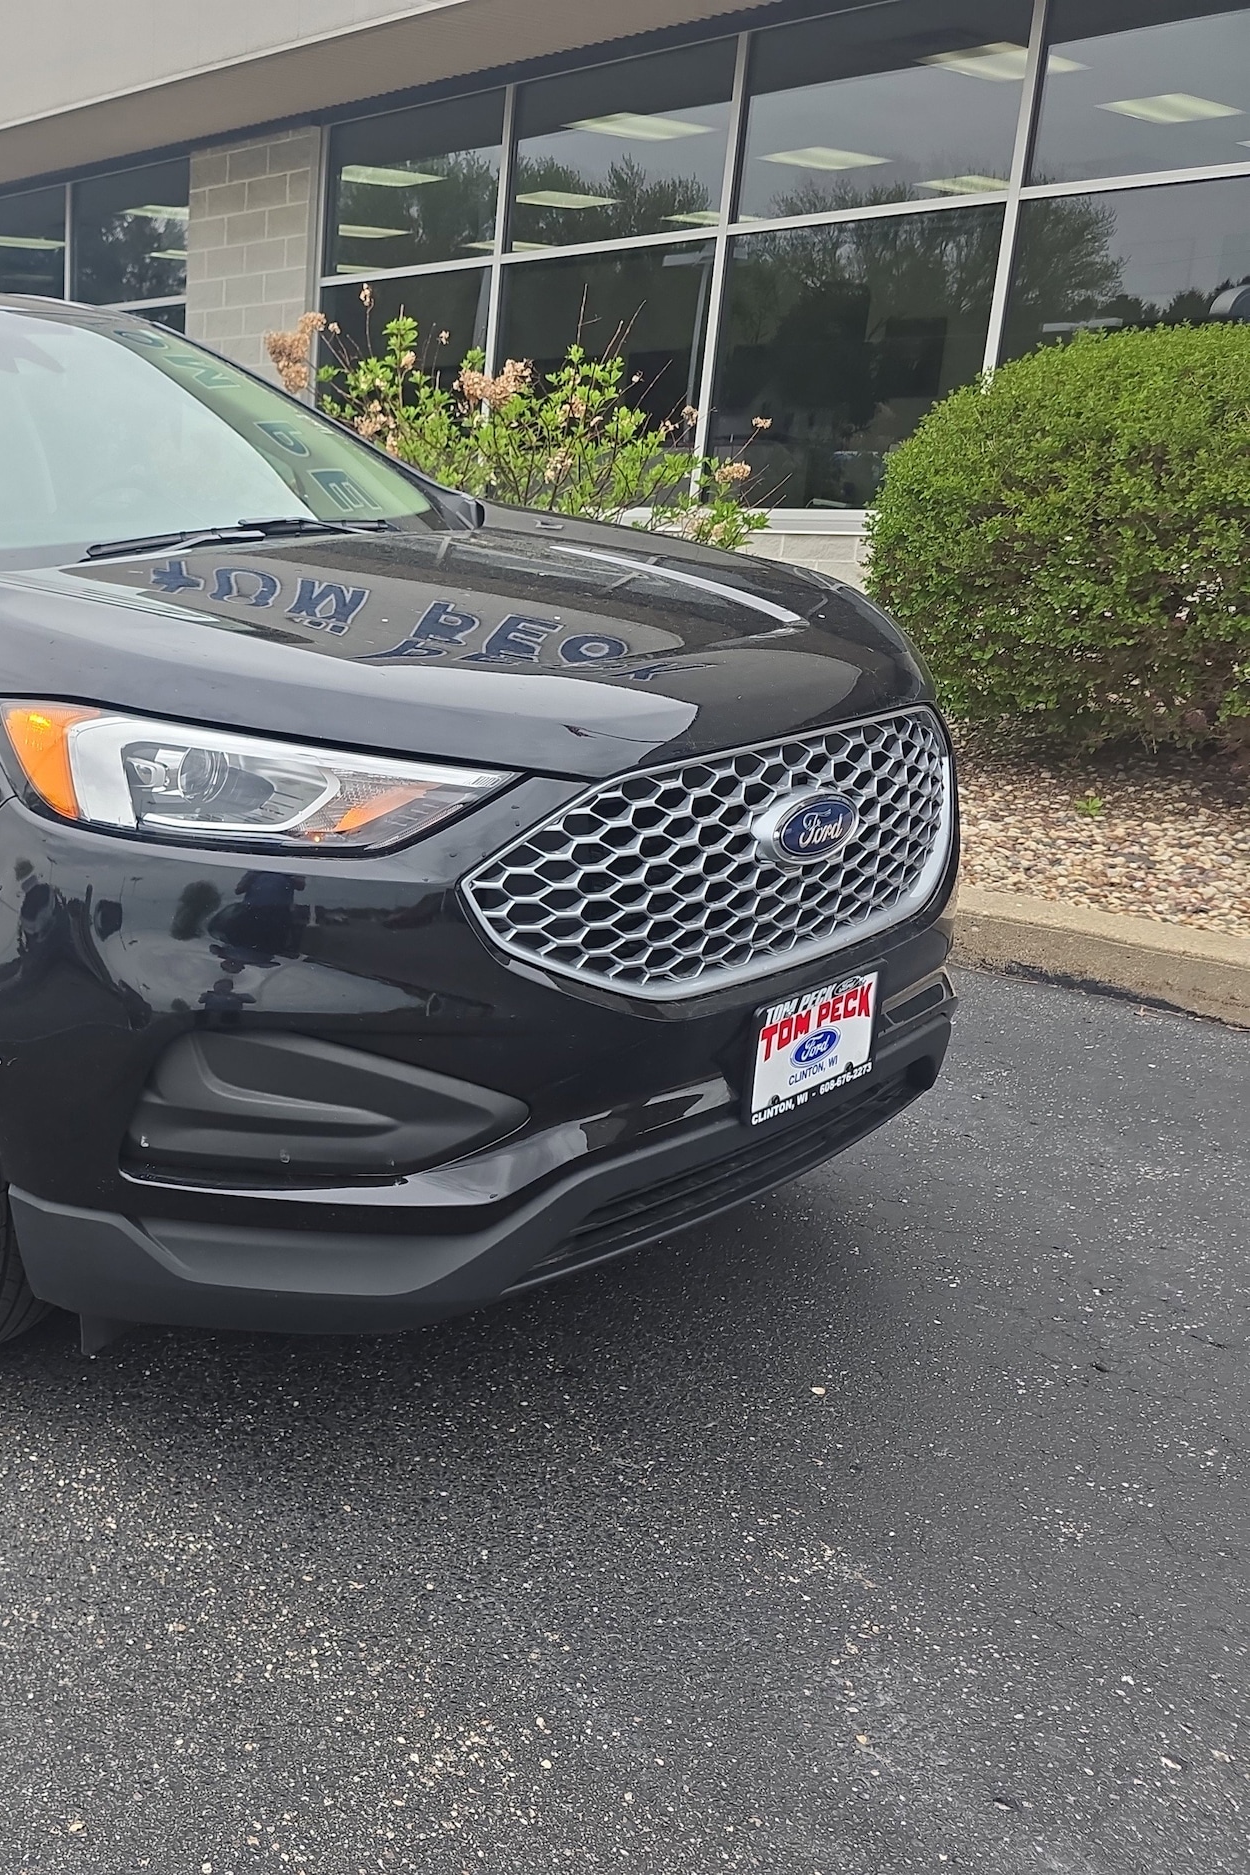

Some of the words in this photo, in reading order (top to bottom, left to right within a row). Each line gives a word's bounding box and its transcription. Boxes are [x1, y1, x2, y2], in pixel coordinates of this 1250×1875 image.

[798, 808, 844, 848] Ford
[761, 1009, 812, 1062] TOM
[817, 982, 873, 1027] PECK
[766, 998, 798, 1024] TOM
[800, 984, 836, 1010] PECK
[801, 1034, 831, 1061] Ford
[789, 1063, 825, 1085] CLINTON,
[828, 1055, 838, 1067] WI
[752, 1100, 795, 1125] CLINTON,
[797, 1093, 808, 1105] WI
[820, 1062, 872, 1095] 608-676-2273
